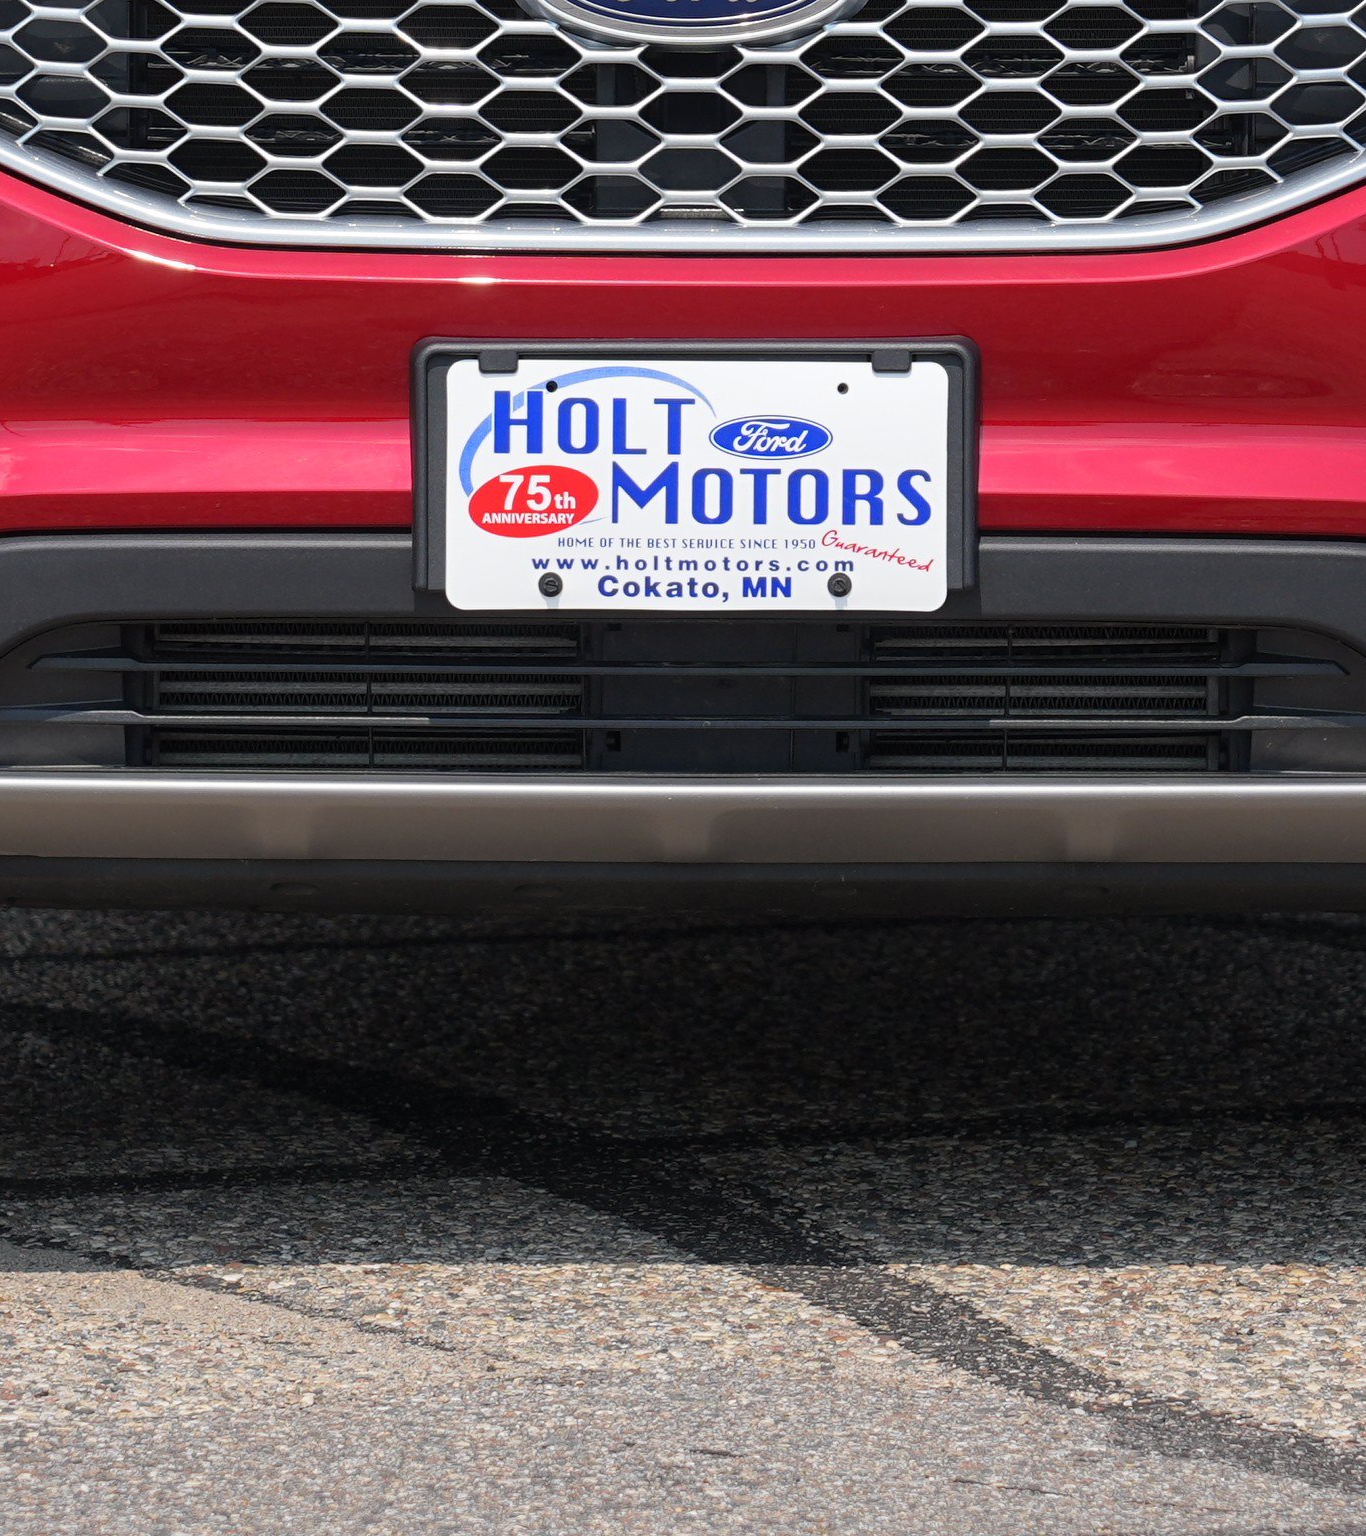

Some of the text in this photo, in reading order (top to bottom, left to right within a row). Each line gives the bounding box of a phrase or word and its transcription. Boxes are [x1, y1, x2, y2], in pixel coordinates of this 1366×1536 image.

[493, 390, 696, 456] HOLT
[732, 421, 809, 453] Ford
[498, 474, 577, 512] 75th
[611, 461, 932, 527] MOTORS
[481, 512, 575, 525] ANNIVERSARY
[557, 537, 816, 550] HOME OF THE BEST SERVICE SINCE 1950
[821, 529, 934, 573] Guaranteed
[531, 555, 855, 572] www.holtmotors.com
[597, 574, 792, 603] Cokato, MN
